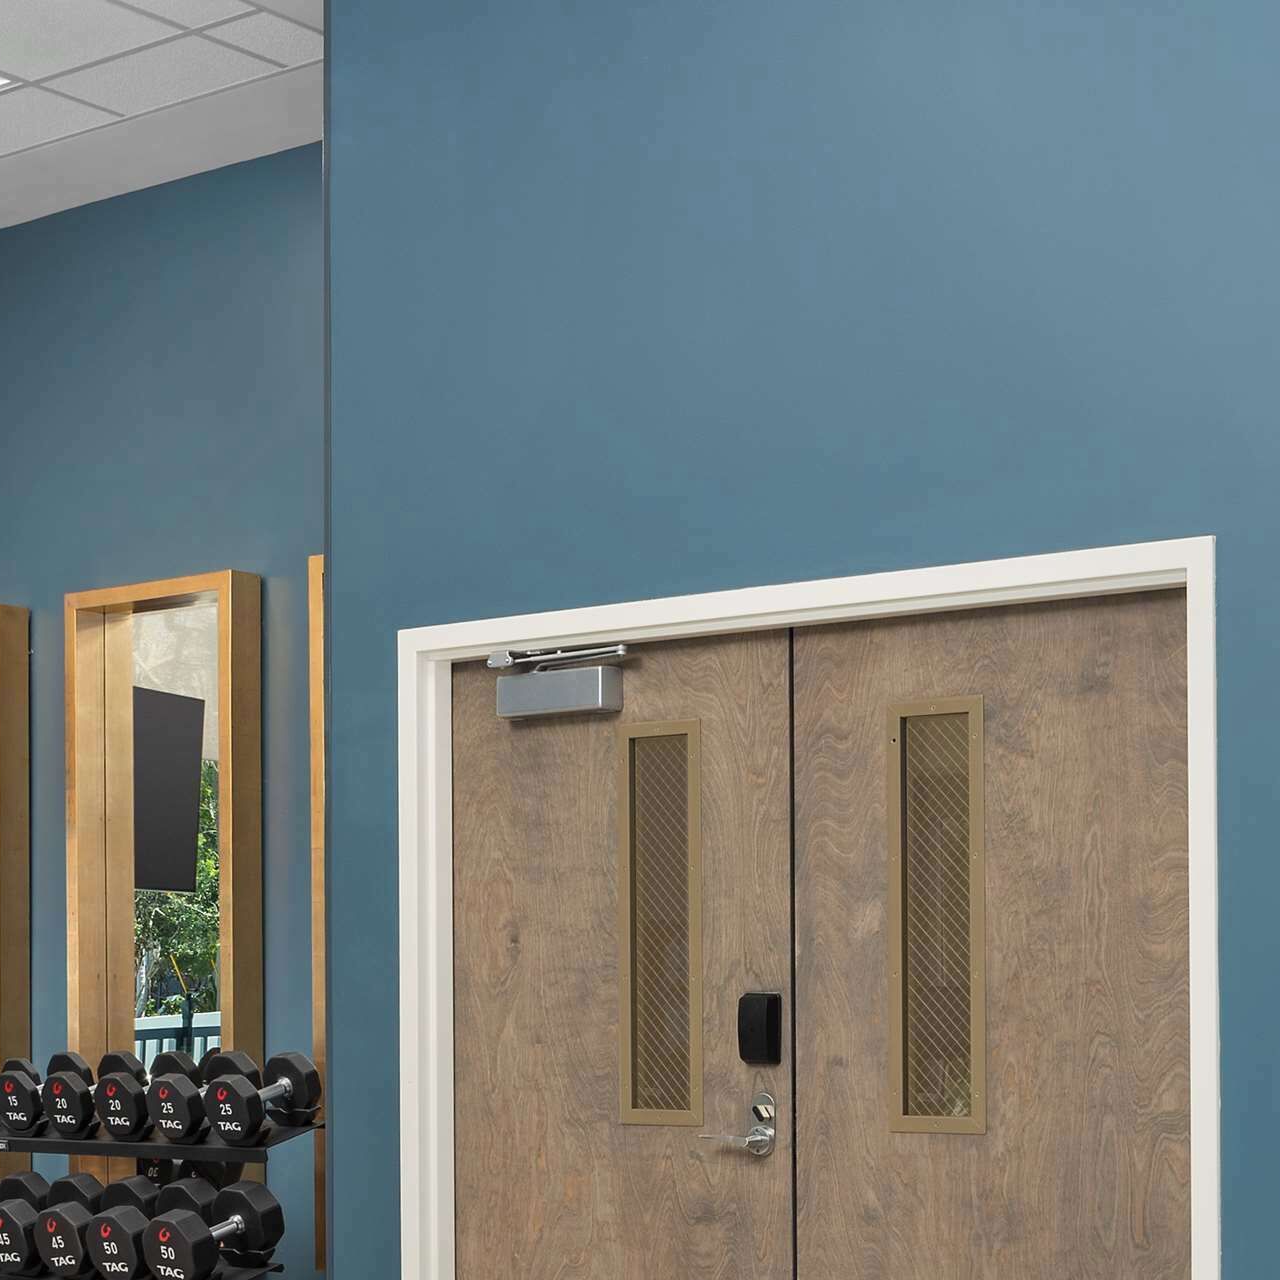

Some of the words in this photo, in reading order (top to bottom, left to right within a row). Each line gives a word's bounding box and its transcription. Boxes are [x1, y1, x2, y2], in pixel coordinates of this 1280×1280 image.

[8, 1096, 18, 1106] 15
[55, 1098, 67, 1109] 20
[109, 1099, 121, 1110] 20
[161, 1102, 173, 1113] 25
[220, 1104, 232, 1115] 25
[6, 1112, 27, 1121] TAG
[54, 1114, 76, 1124] TAG
[107, 1116, 130, 1126] TAG
[159, 1119, 182, 1130] TAG
[218, 1121, 242, 1132] TAG
[52, 1235, 65, 1249] 45
[103, 1242, 118, 1255] 50
[160, 1245, 175, 1260] 50
[50, 1255, 76, 1267] TAG
[102, 1262, 129, 1273] TAG
[156, 1265, 185, 1280] TAG
